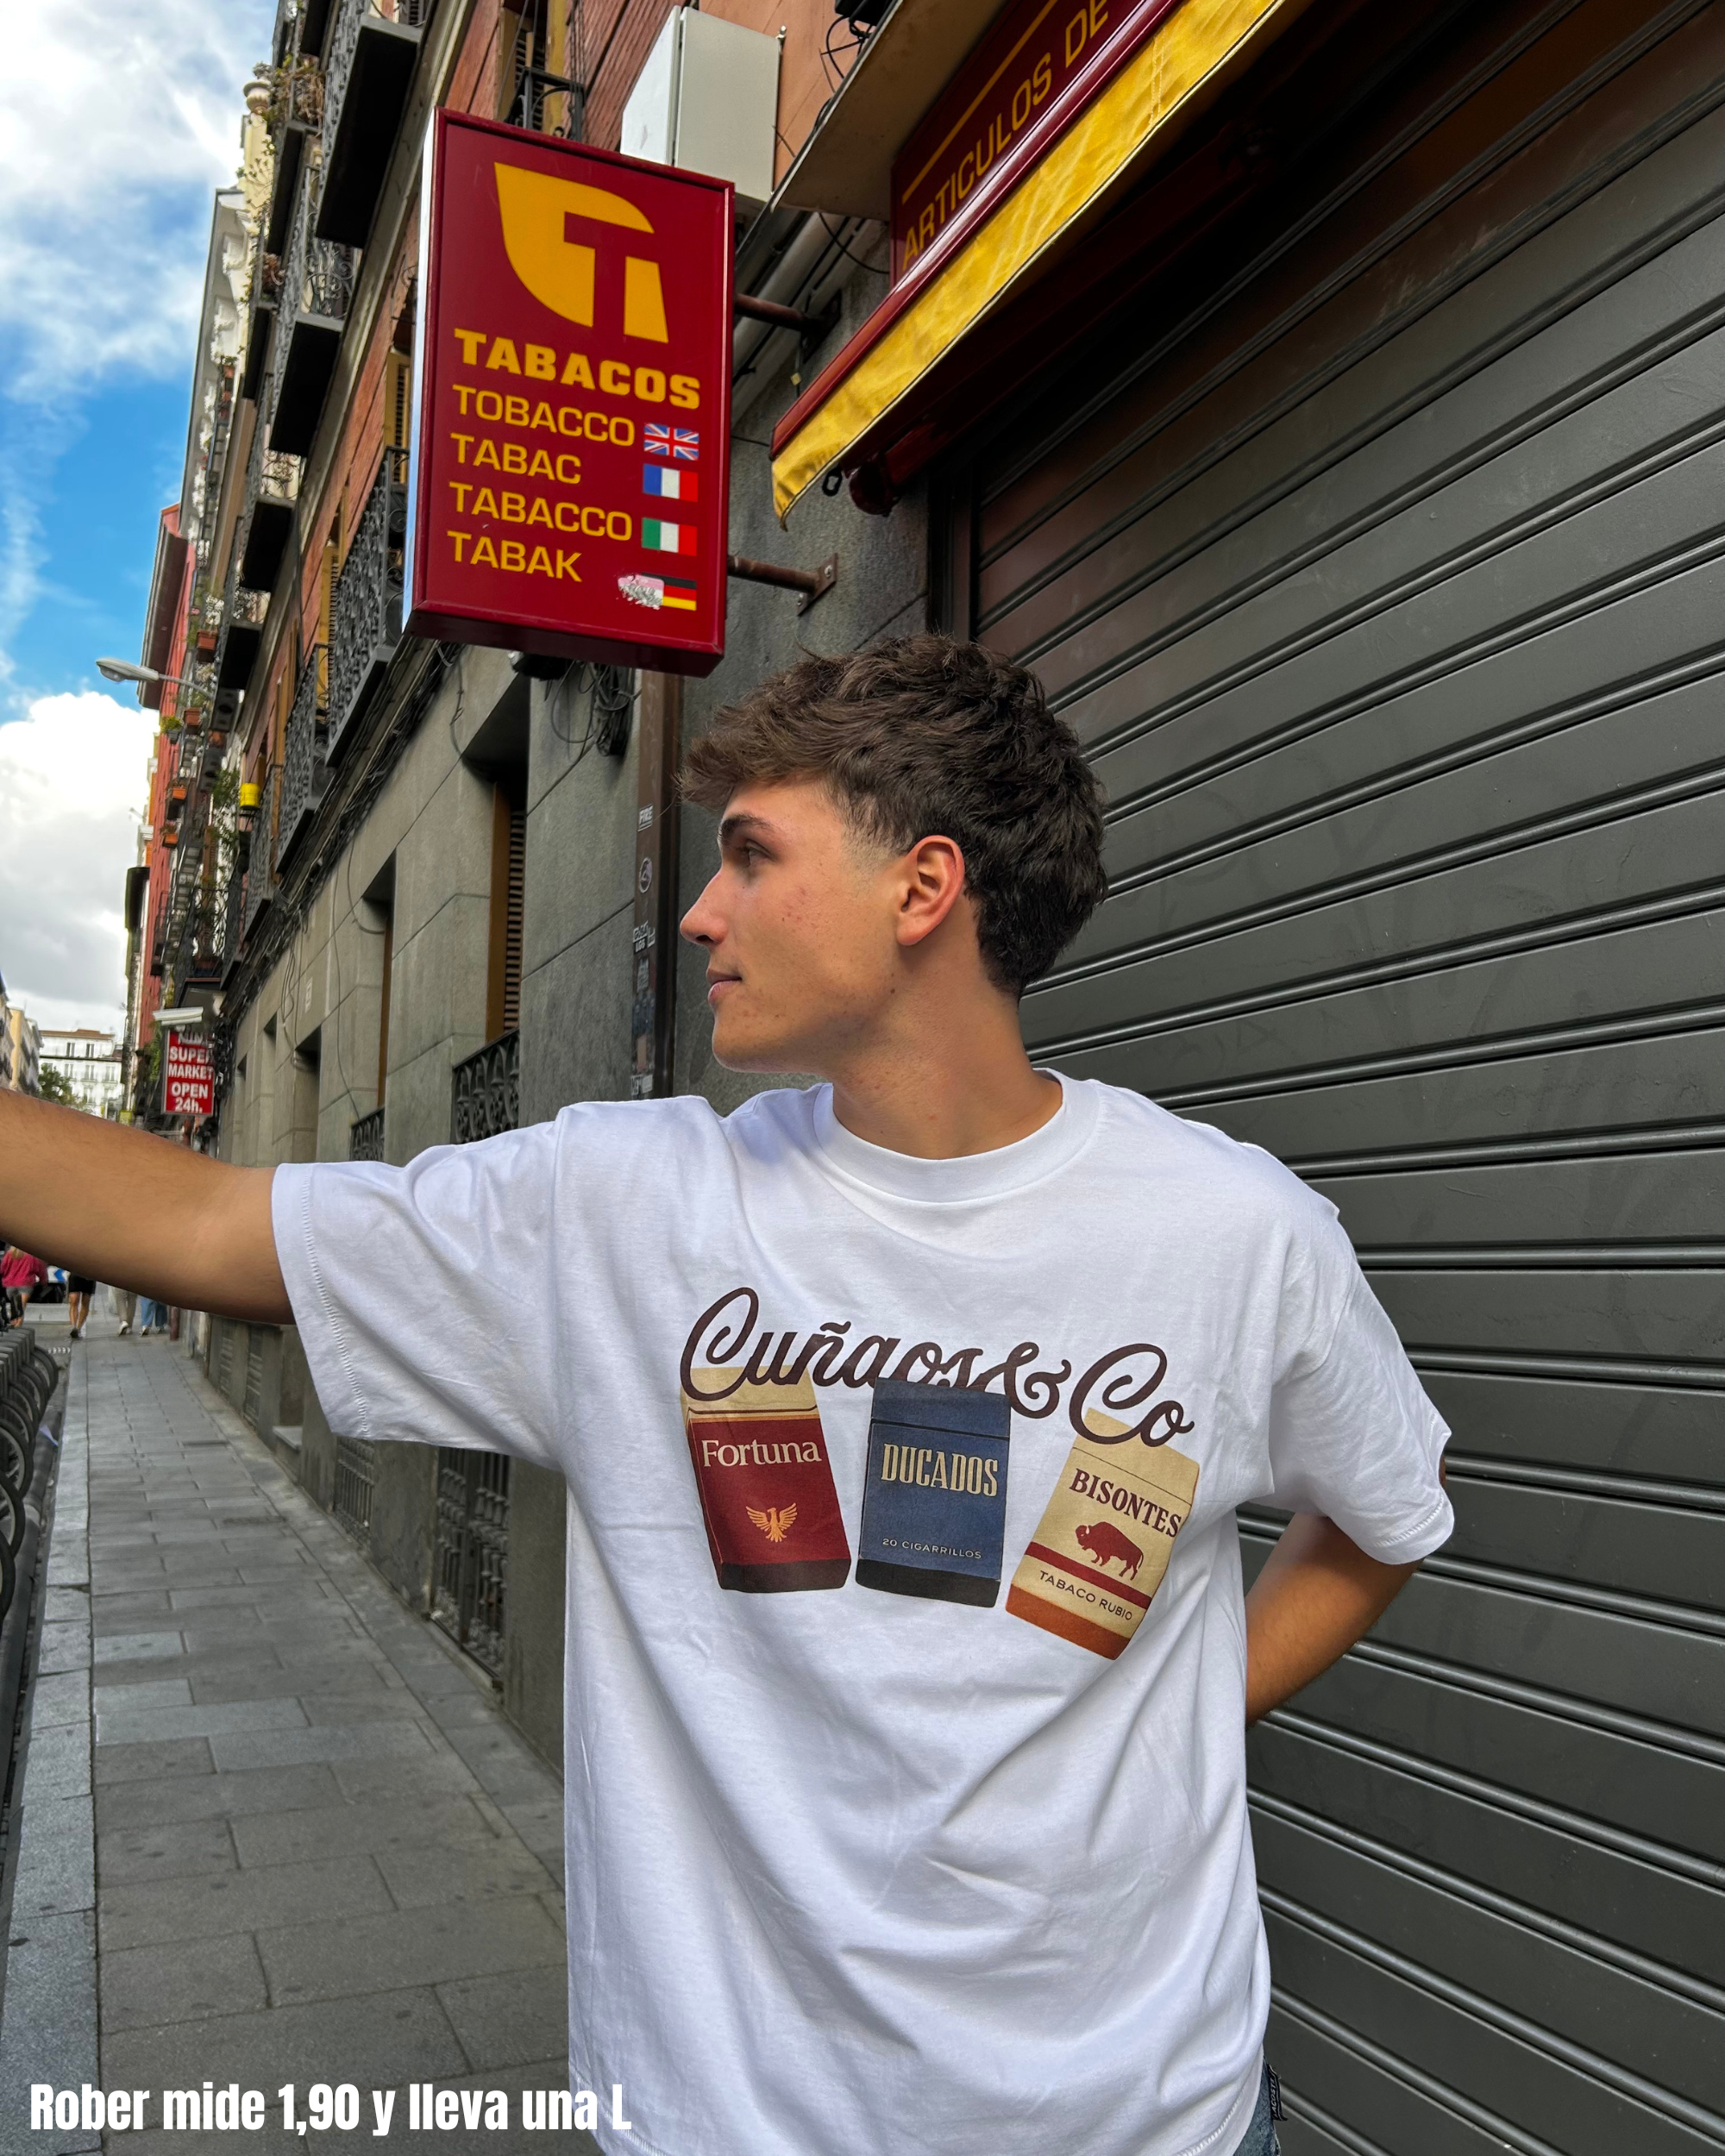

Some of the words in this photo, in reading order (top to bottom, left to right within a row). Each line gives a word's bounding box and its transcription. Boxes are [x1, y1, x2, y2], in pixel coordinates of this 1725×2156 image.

[902, 53, 1051, 272] ARTICULOS
[1065, 0, 1109, 68] DE
[454, 328, 700, 410] TABACOS
[452, 384, 636, 447] TOBACCO
[450, 432, 582, 485] TABAC
[448, 480, 632, 542] TABACCO
[447, 530, 582, 582] TABAK
[168, 1063, 214, 1080] MARKET
[171, 1081, 208, 1100] OPEN
[175, 1097, 203, 1113] 24h.
[701, 1439, 822, 1467] Fortuna
[881, 1443, 998, 1497] DUCADOS
[1069, 1468, 1182, 1538] BISONTES
[882, 1538, 898, 1547] 20
[901, 1540, 982, 1559] CIGARRILLOS
[1039, 1570, 1096, 1603] TABACO
[1099, 1598, 1133, 1621] RUBIO
